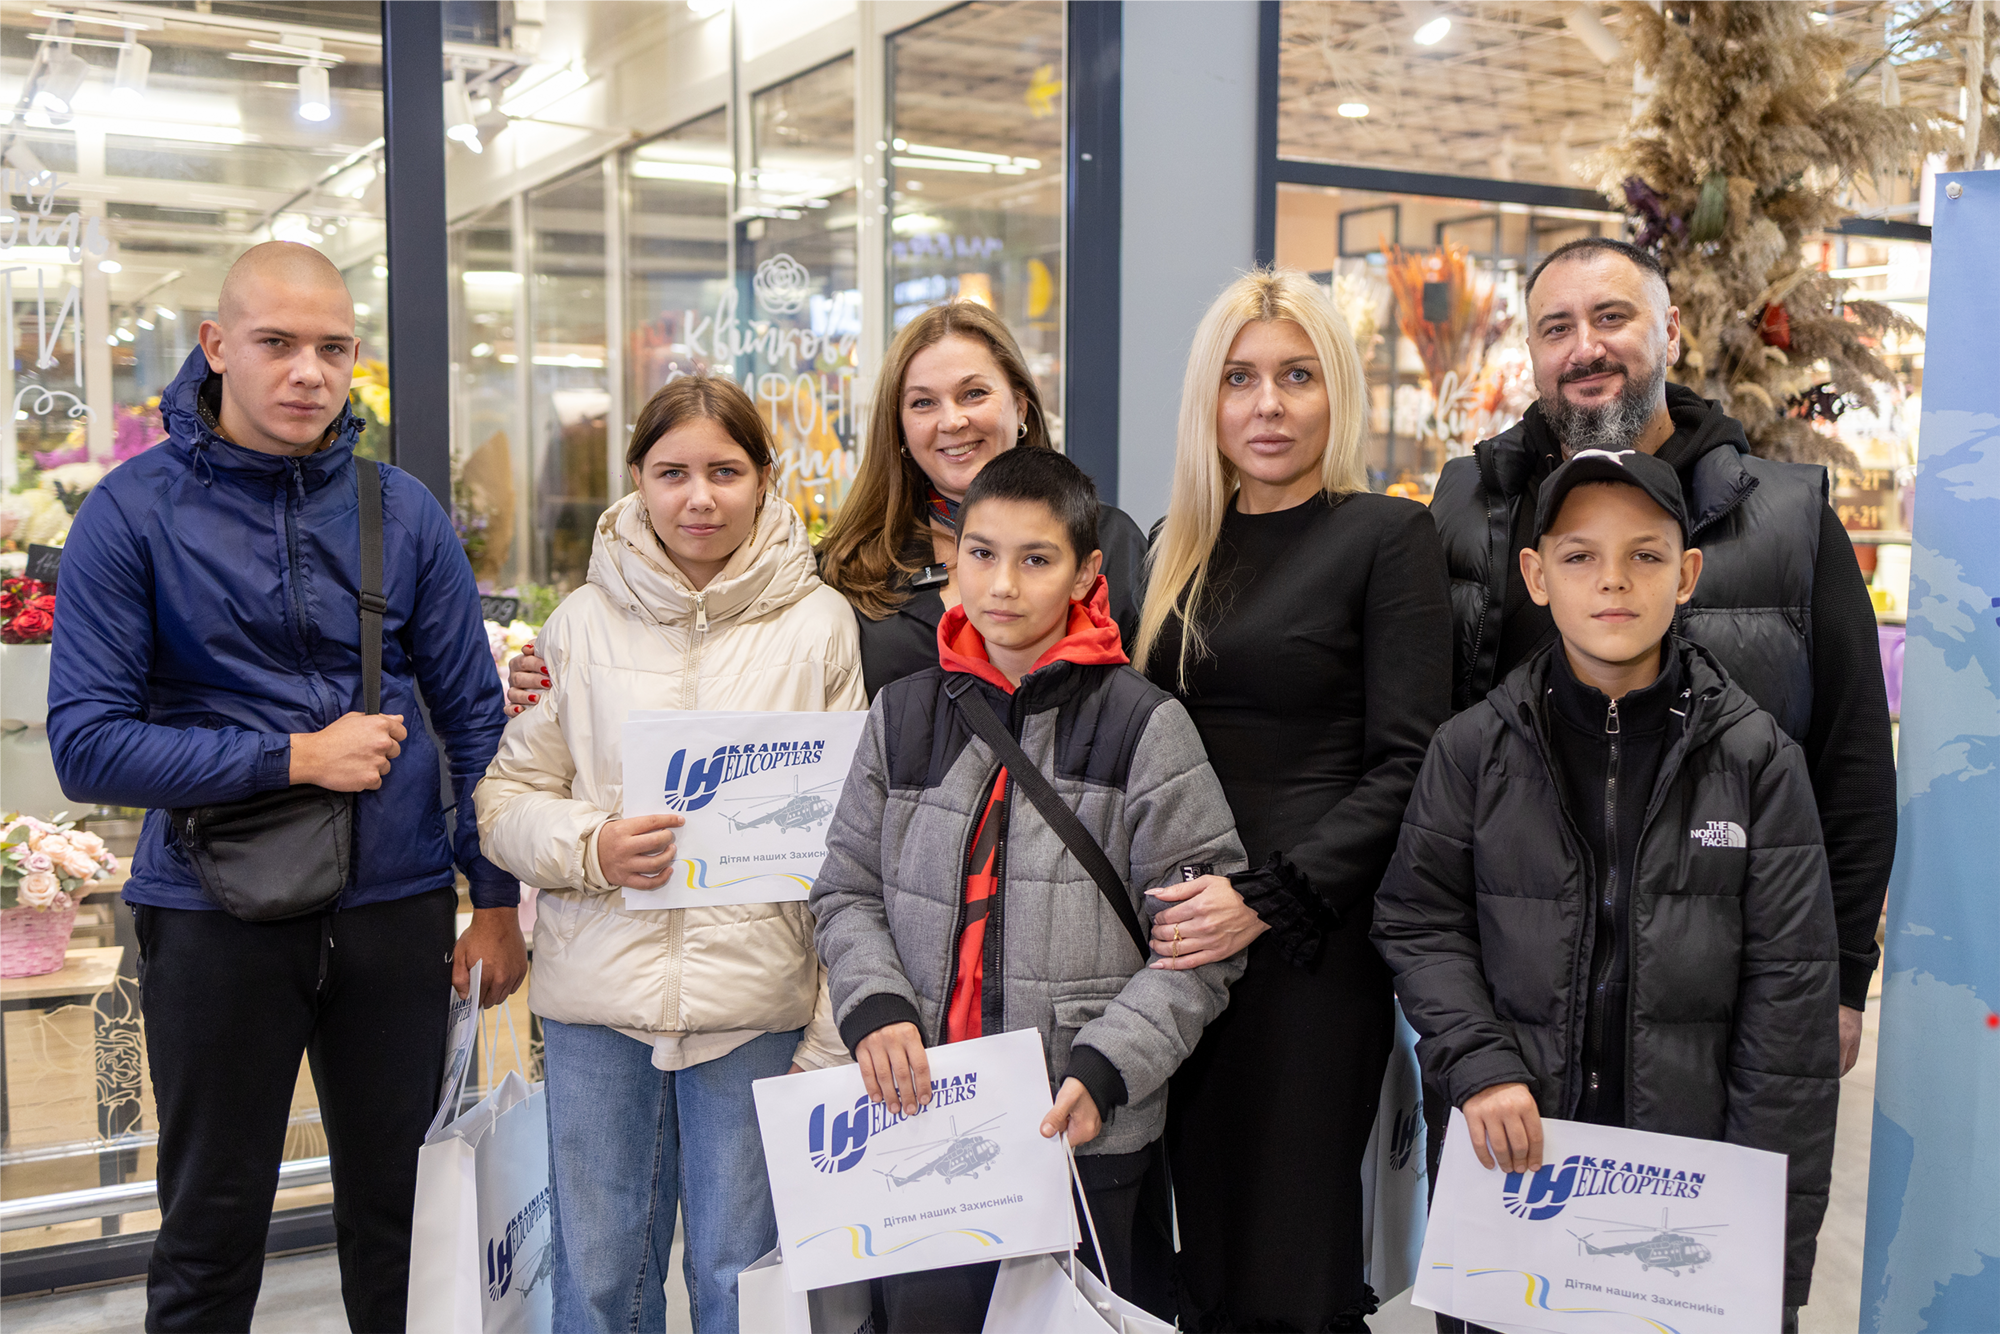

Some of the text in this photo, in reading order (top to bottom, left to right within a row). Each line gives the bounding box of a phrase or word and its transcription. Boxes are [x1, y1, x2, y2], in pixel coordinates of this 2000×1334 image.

[1705, 821, 1728, 830] THE
[1690, 829, 1728, 839] NORTH
[1701, 838, 1728, 847] FACE
[719, 849, 829, 866] Дітям наших Захисн
[883, 1194, 1024, 1228] Дітям наших Захисників
[1564, 1278, 1724, 1316] Дітям наших Захисників
